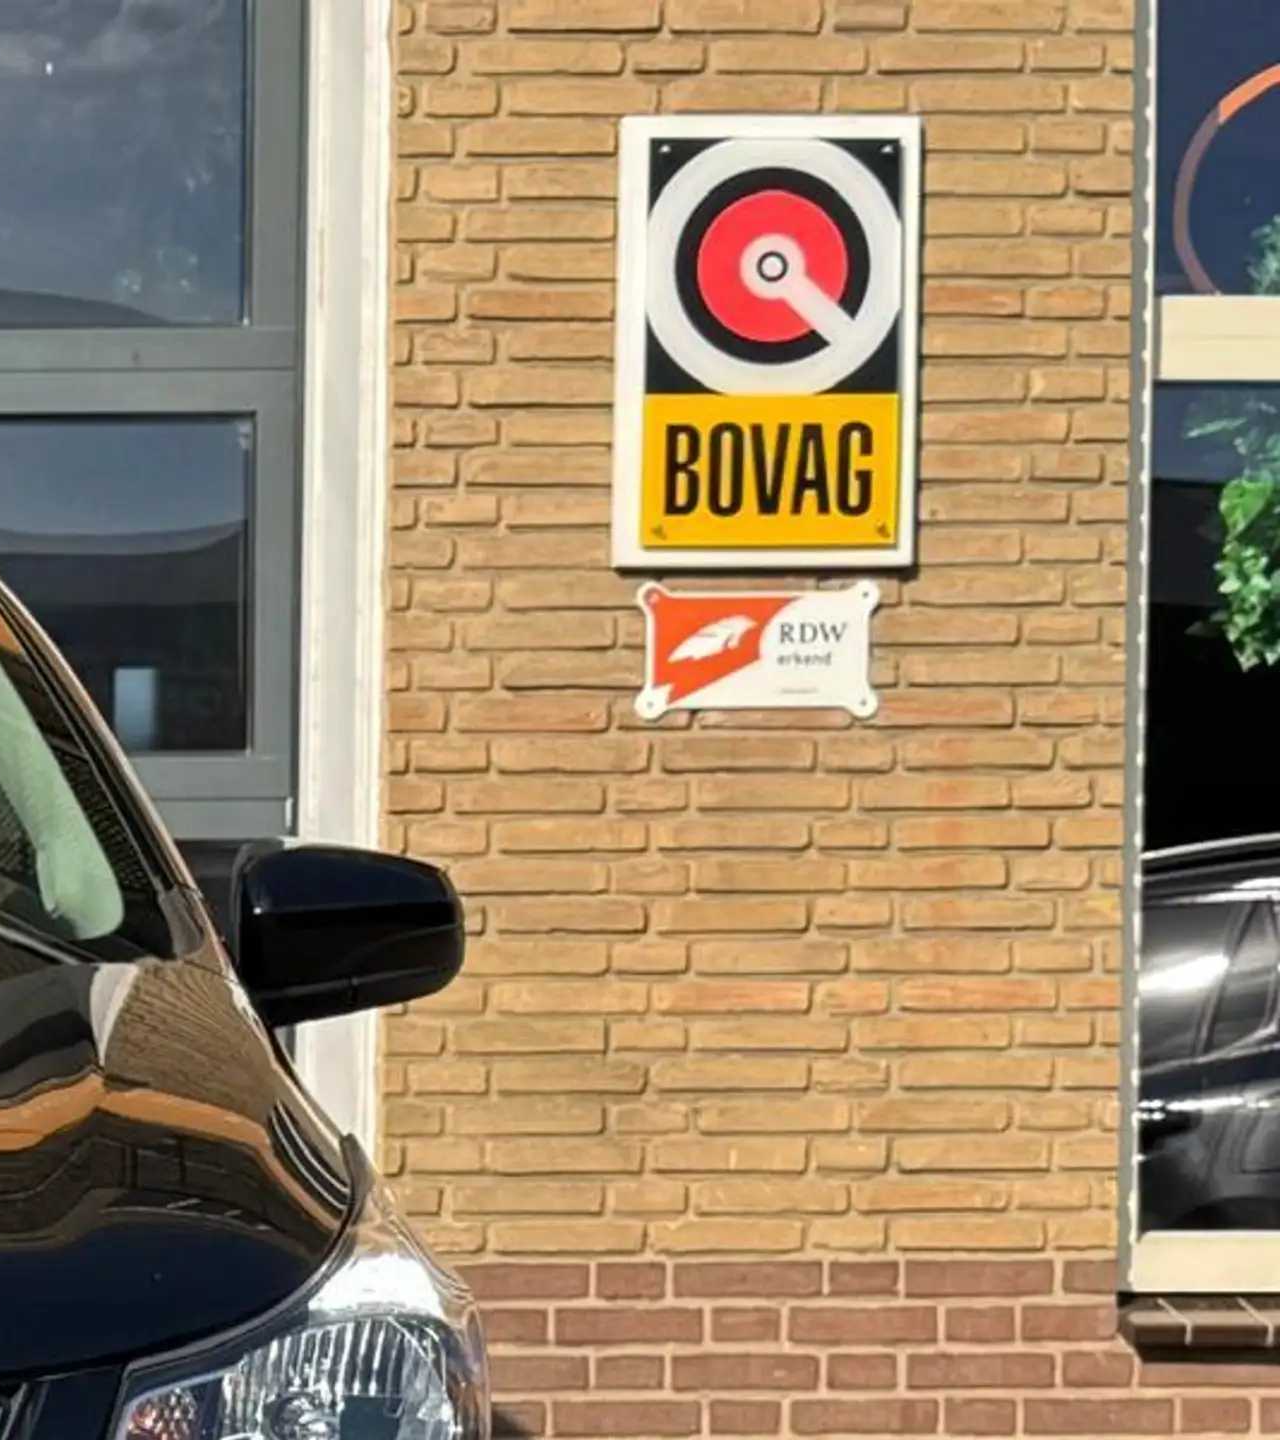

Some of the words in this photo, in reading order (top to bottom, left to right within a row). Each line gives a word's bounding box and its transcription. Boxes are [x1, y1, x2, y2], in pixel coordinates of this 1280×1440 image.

[663, 421, 874, 518] BOVAG
[780, 622, 848, 645] RDW
[777, 652, 832, 667] erkend
